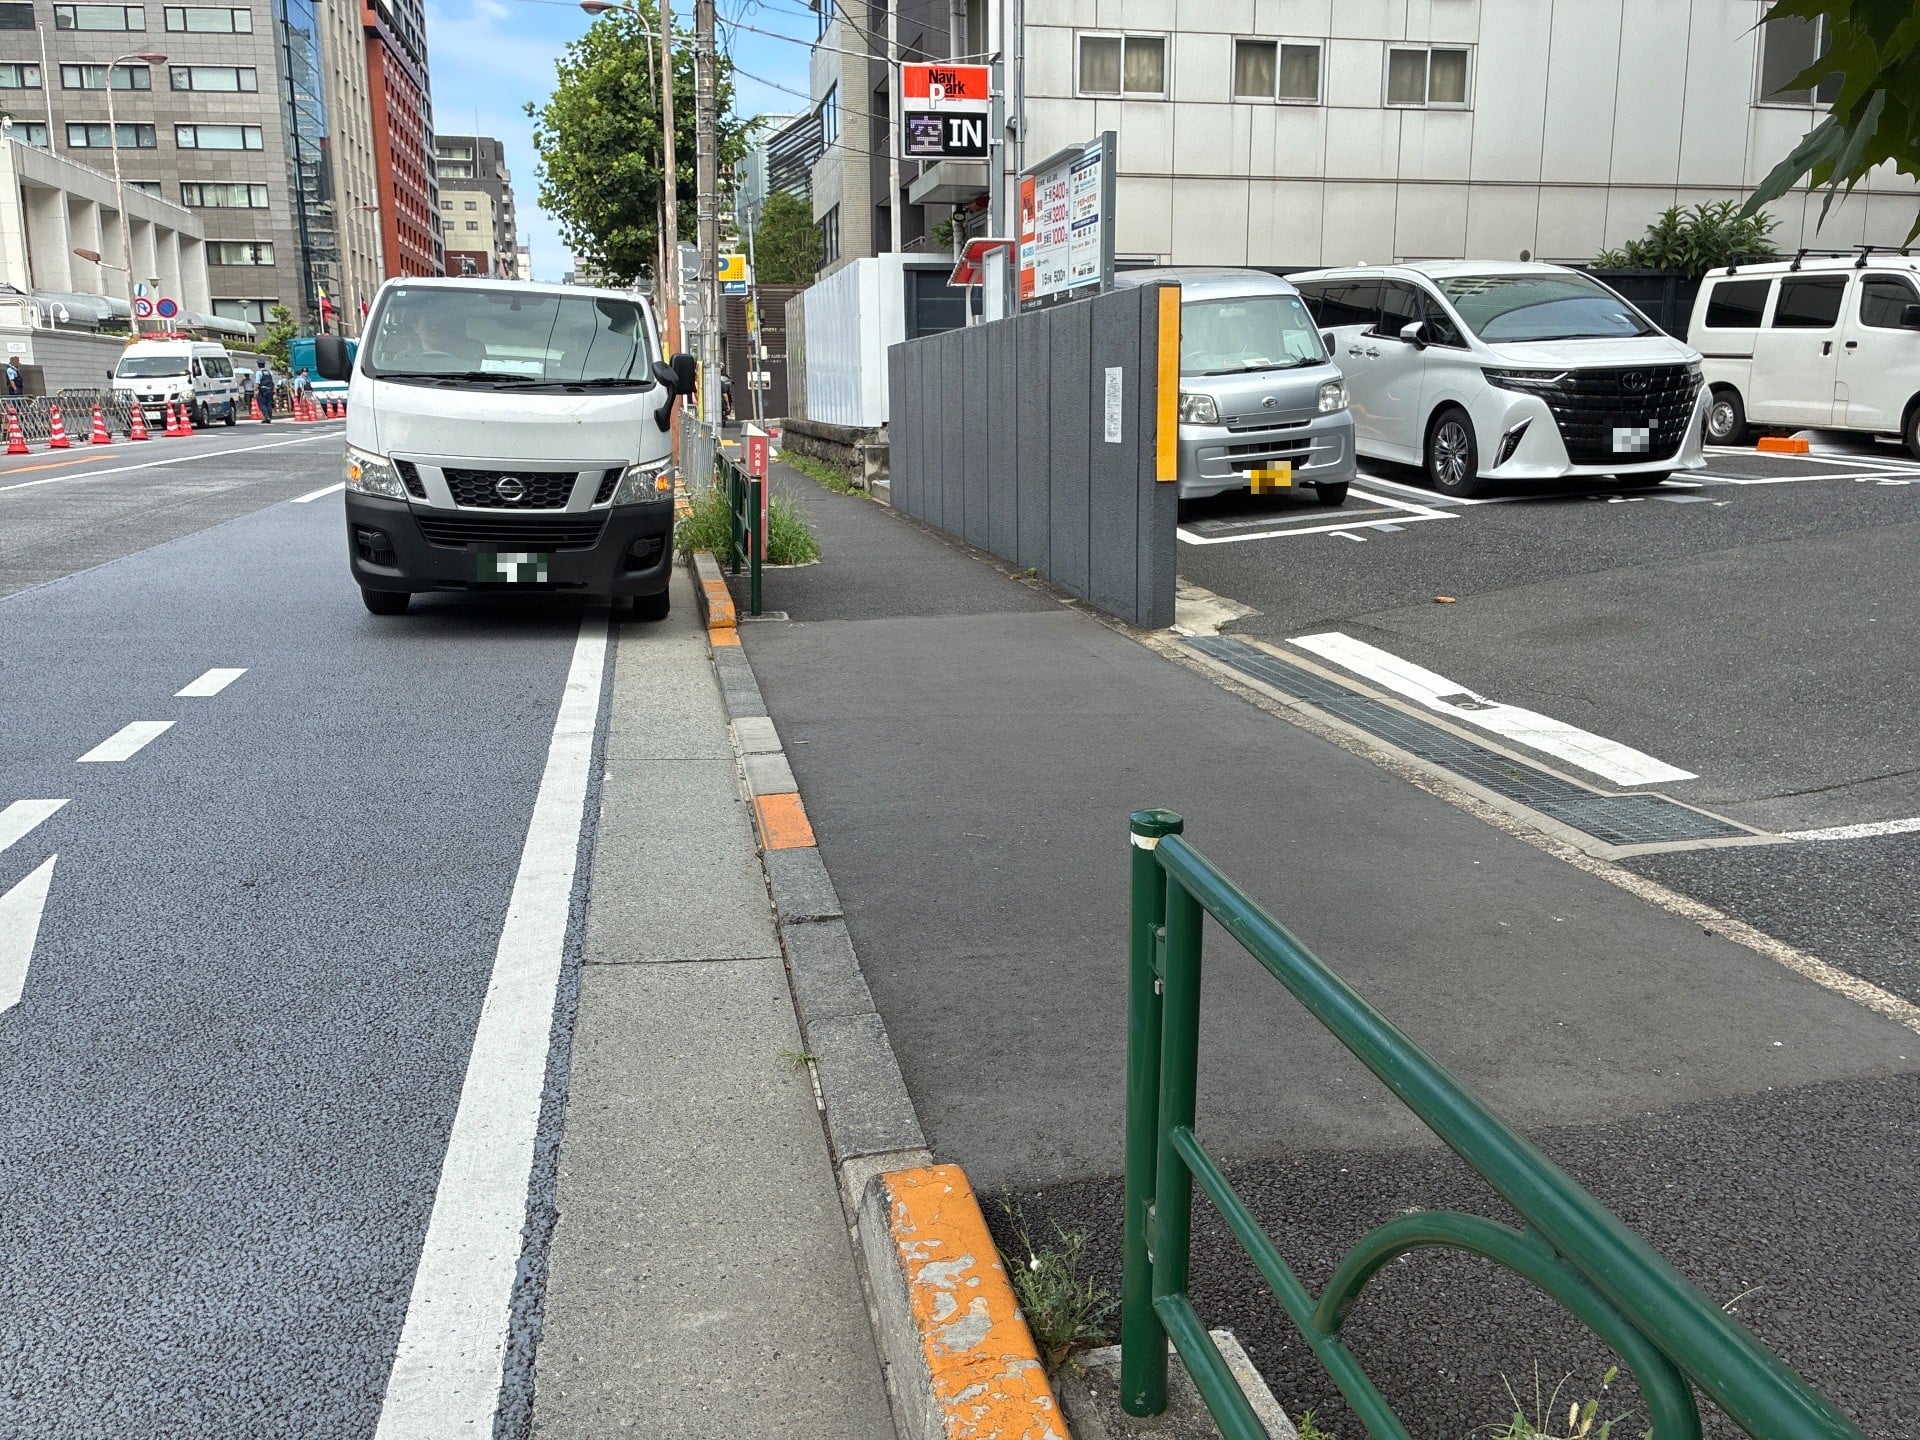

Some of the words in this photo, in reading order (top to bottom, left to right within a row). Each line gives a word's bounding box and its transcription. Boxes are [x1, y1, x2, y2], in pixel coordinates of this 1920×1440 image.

[929, 69, 956, 83] Navi
[929, 80, 965, 109] Park
[910, 116, 942, 152] 空
[949, 119, 982, 148] IN
